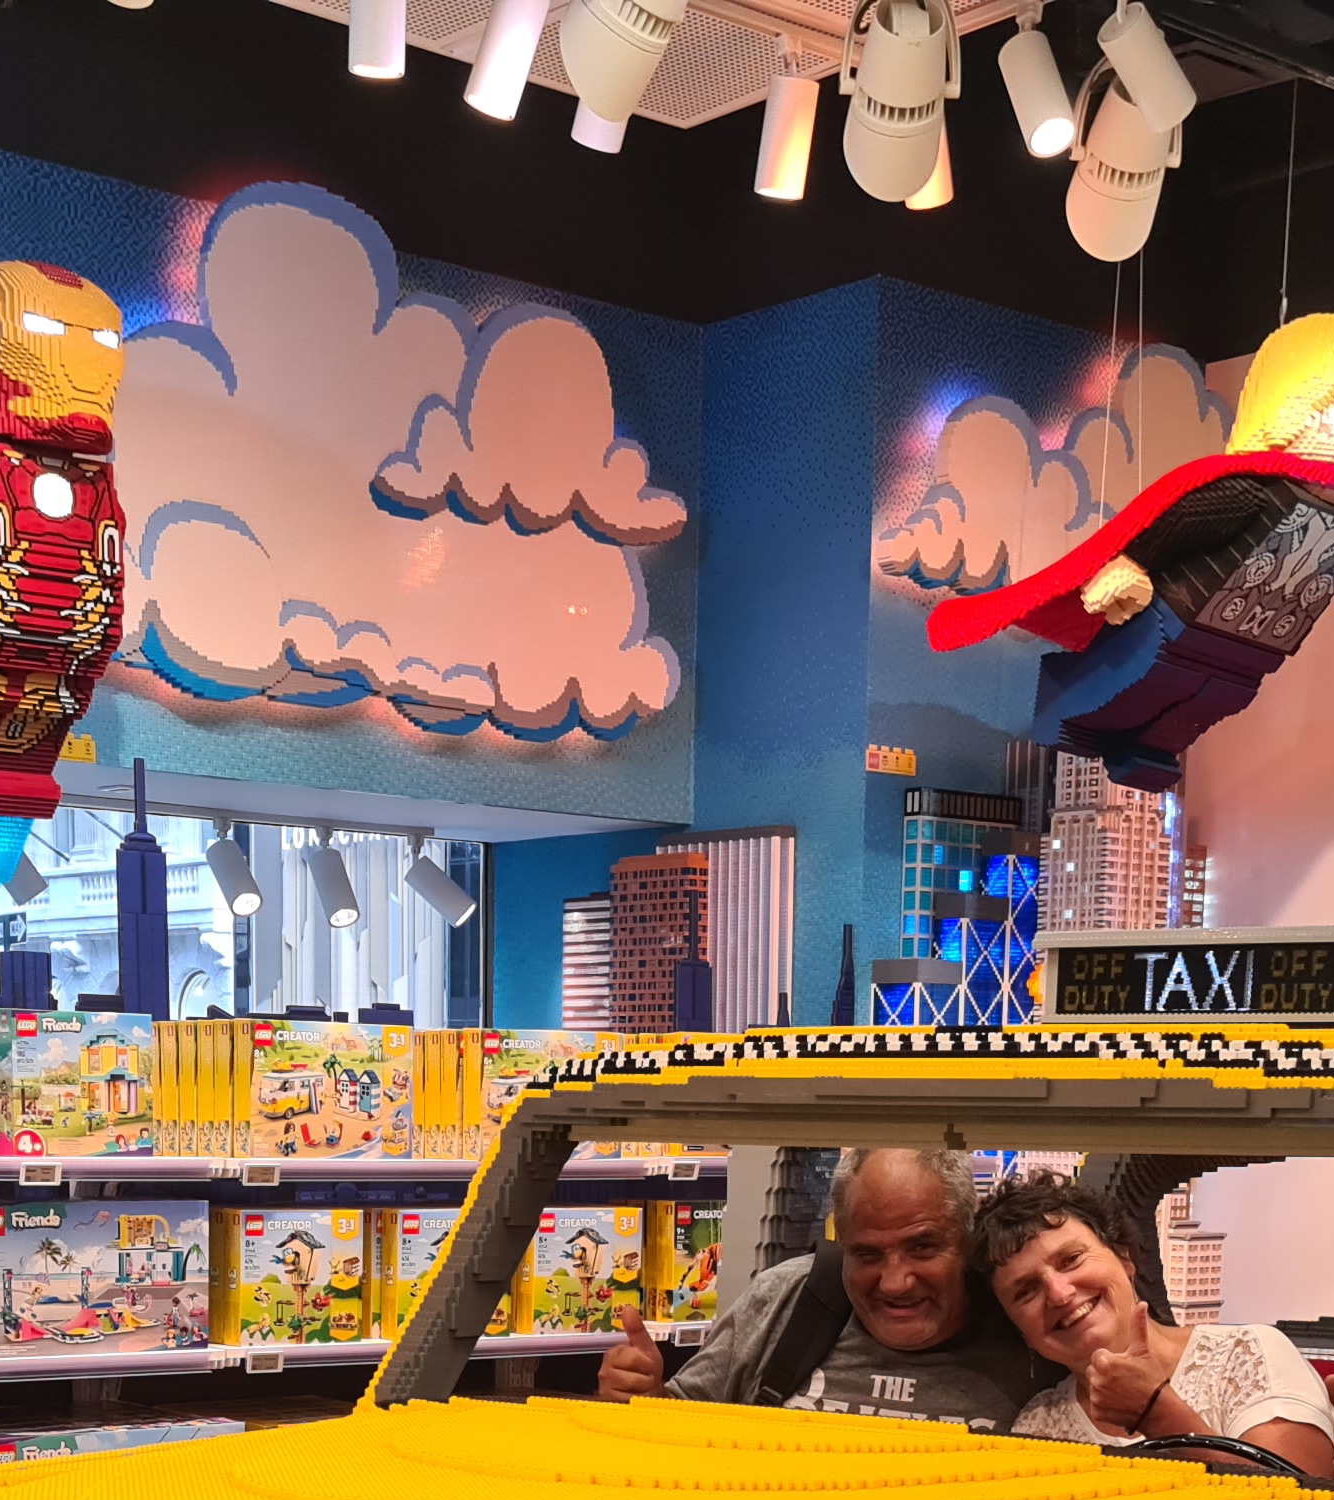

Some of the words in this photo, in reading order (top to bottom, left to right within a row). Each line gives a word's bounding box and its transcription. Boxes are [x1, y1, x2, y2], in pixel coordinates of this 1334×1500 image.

[1074, 954, 1126, 980] OFF
[1134, 950, 1255, 1011] TAXI
[1271, 951, 1327, 978] OFF
[1064, 985, 1130, 1011] DUTY
[1260, 983, 1333, 1010] DUTY
[42, 1017, 82, 1032] Friends
[276, 1030, 320, 1042] CREATOR
[503, 1040, 542, 1049] CREATOR
[18, 1135, 42, 1153] 4+
[10, 1207, 62, 1229] Friends
[267, 1220, 312, 1230] CREATOR
[403, 1219, 420, 1229] LEGO
[558, 1218, 597, 1228] CREATOR
[538, 1236, 548, 1244] 8+
[870, 1374, 917, 1402] THE
[21, 1441, 73, 1461] Friends
